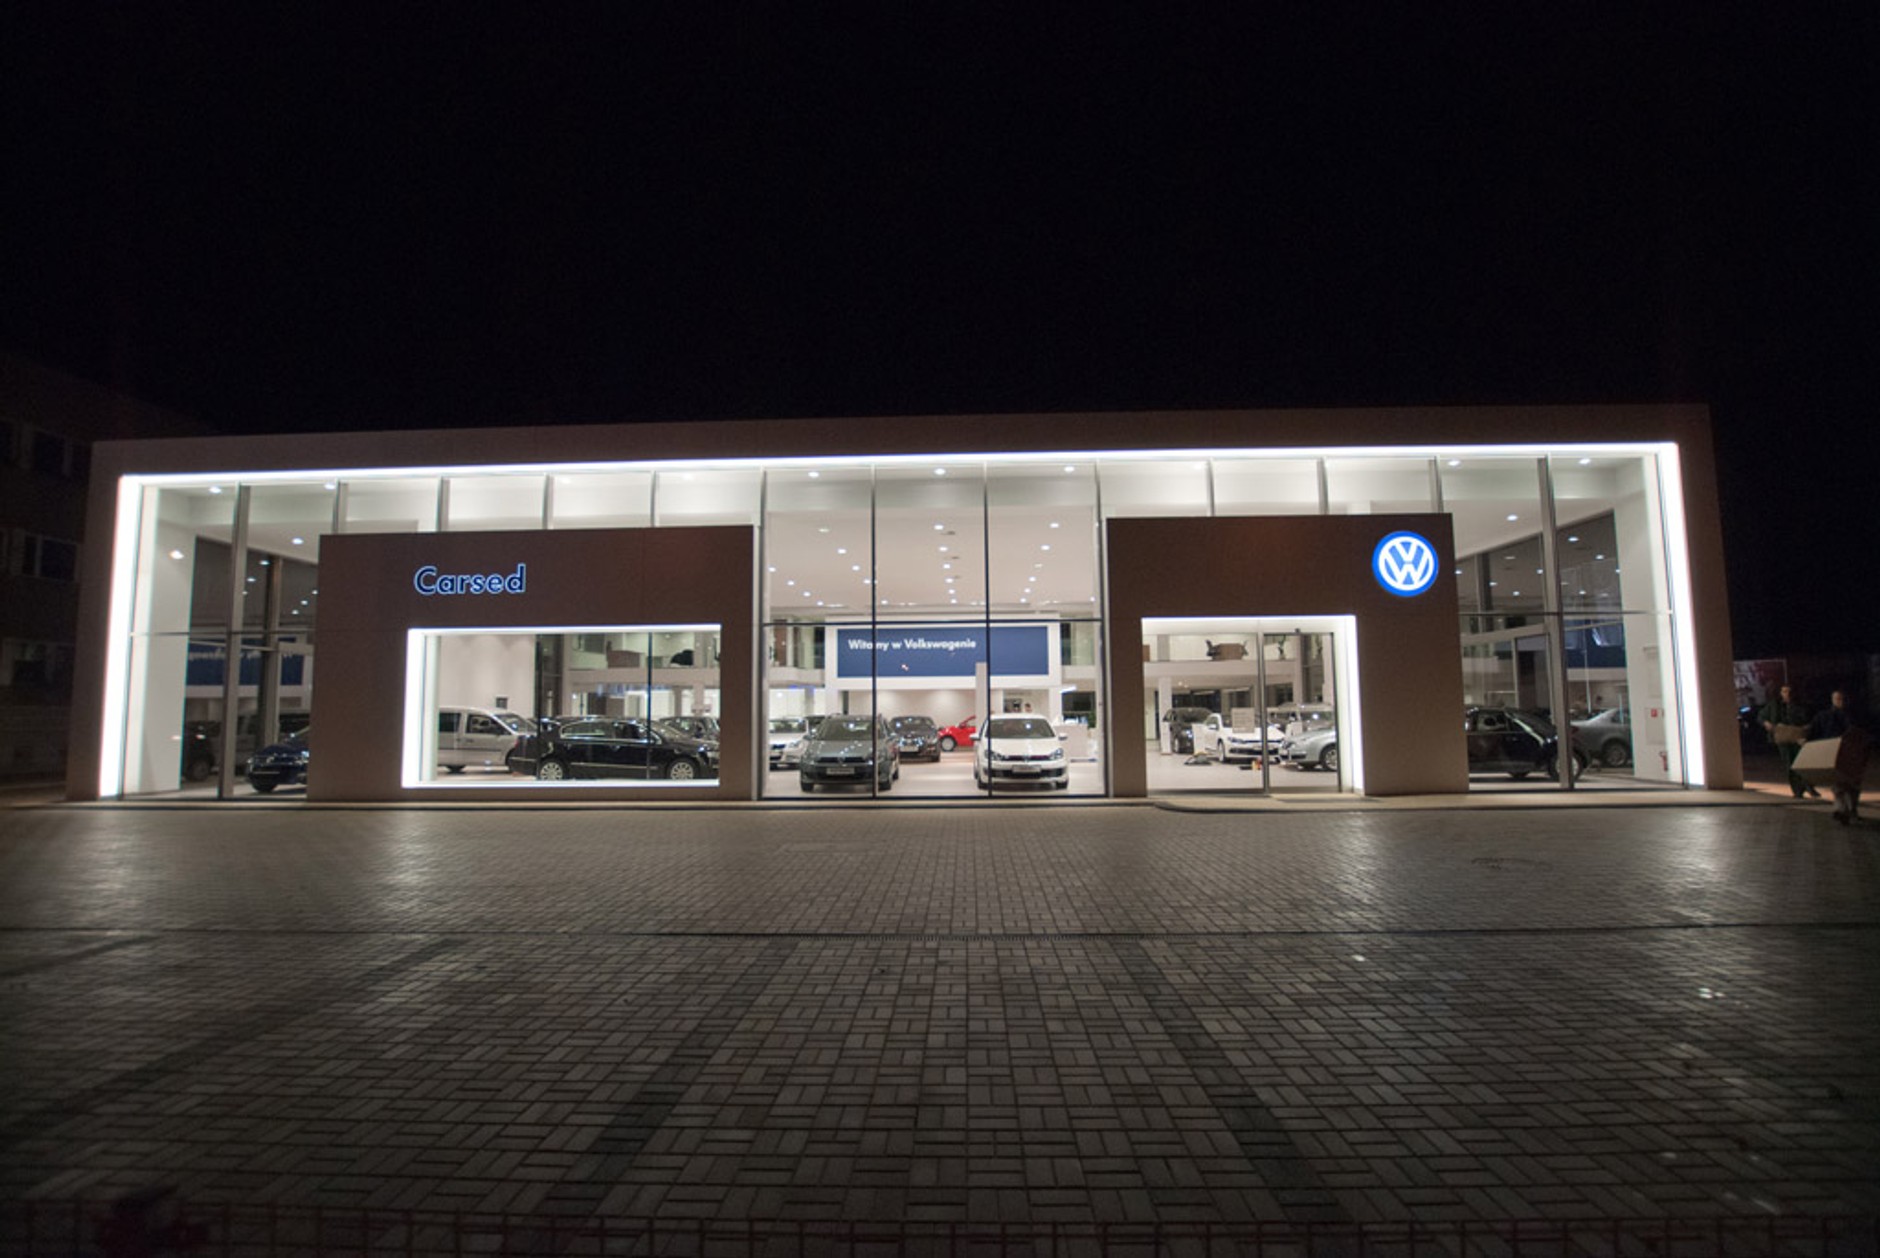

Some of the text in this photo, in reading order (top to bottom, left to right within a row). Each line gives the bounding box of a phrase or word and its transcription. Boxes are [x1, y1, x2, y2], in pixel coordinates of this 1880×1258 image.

[414, 563, 527, 595] Carsed
[848, 638, 976, 651] Witamy w Volkswagenie
